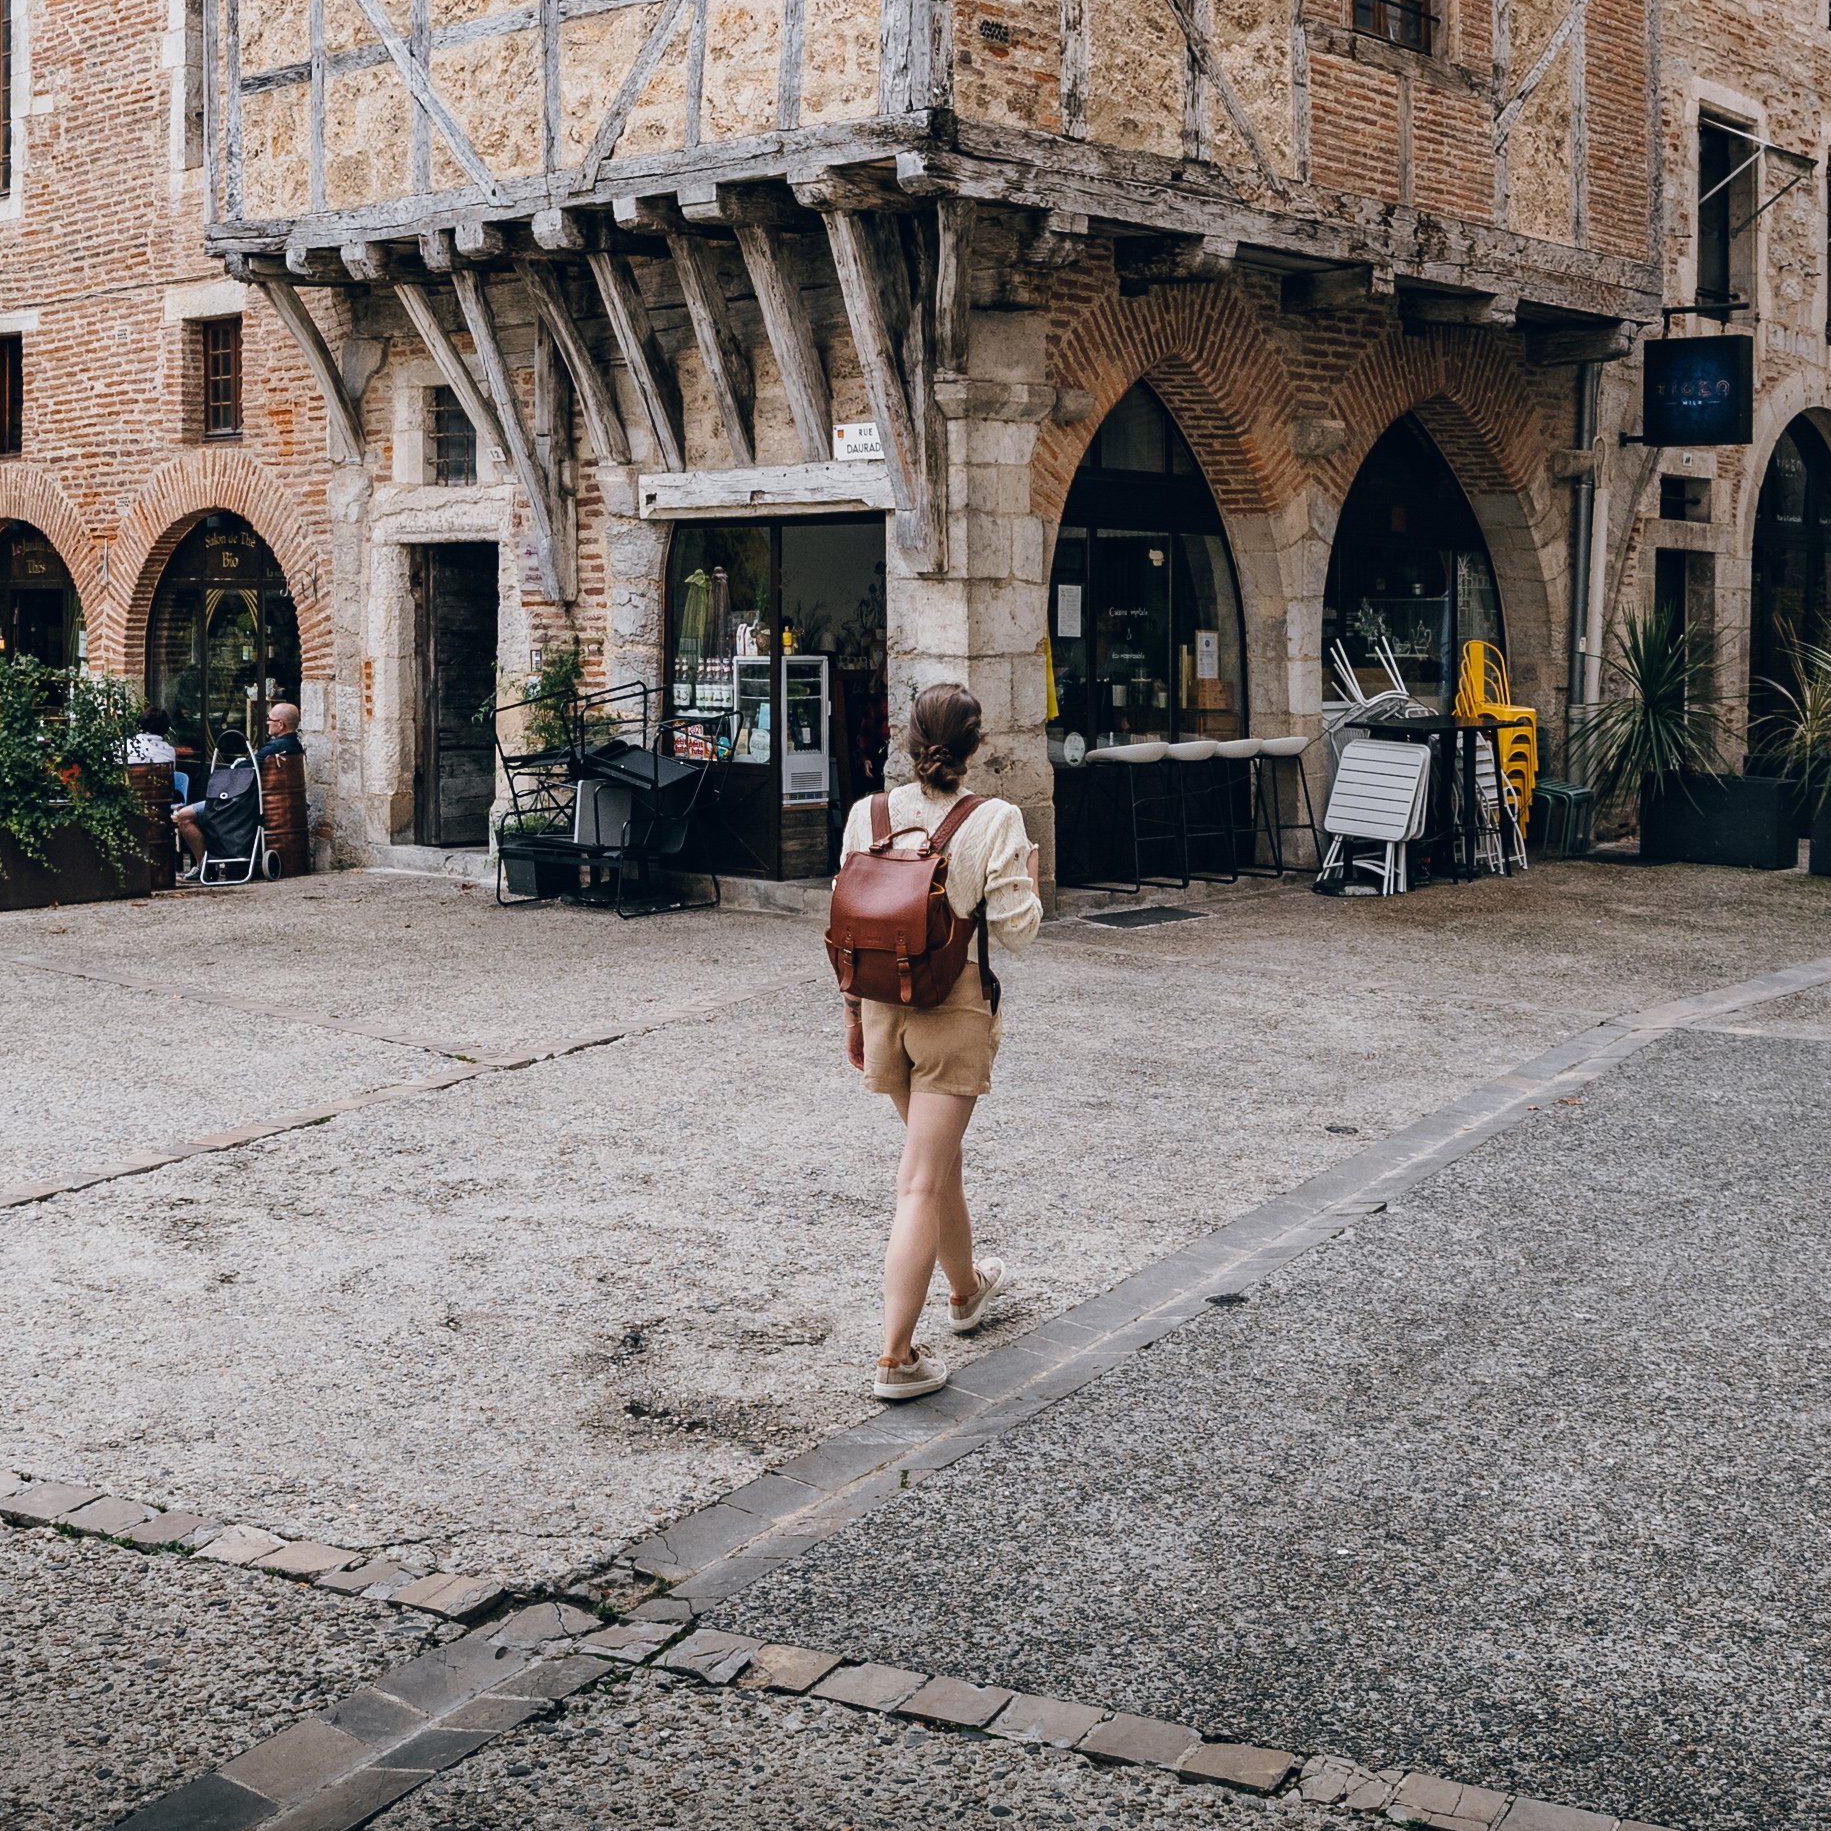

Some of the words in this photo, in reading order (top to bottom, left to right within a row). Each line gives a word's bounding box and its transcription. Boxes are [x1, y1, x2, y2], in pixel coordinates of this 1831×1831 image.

[858, 427, 873, 437] RUE
[489, 449, 501, 459] 12
[846, 442, 881, 455] DAURAD
[221, 551, 240, 568] Bio
